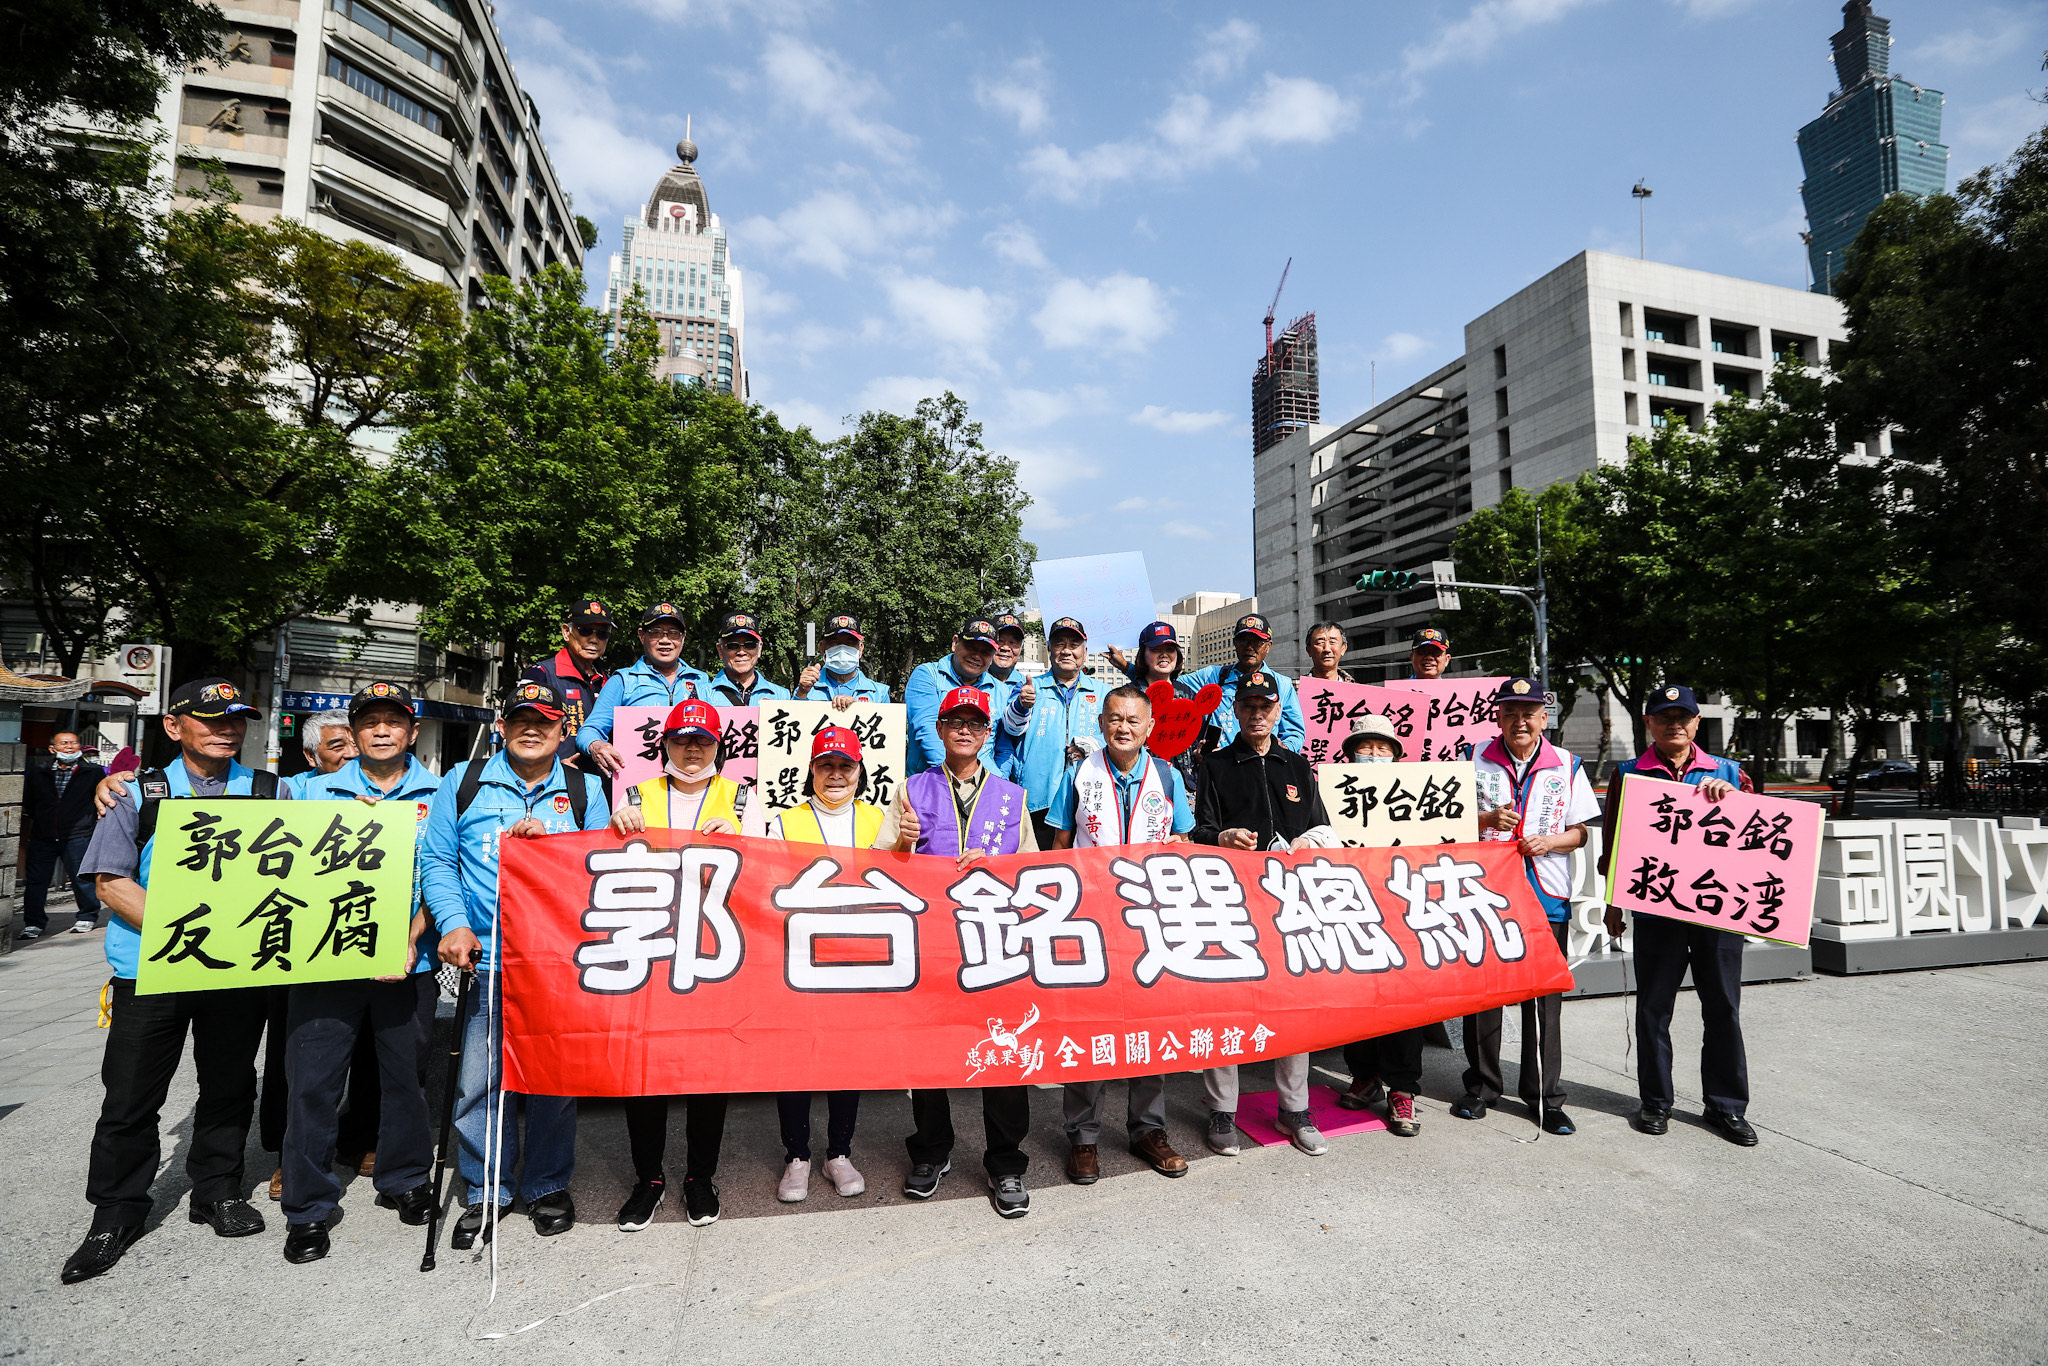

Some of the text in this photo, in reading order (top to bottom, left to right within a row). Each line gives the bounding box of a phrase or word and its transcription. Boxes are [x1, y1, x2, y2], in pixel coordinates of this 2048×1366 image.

[1334, 774, 1464, 827] 郭台銘
[1650, 793, 1793, 861] 郭台銘
[176, 811, 386, 882] 郭台銘
[148, 880, 380, 972] 反貪腐
[576, 840, 1525, 993] 郭台銘選總統
[1627, 856, 1785, 934] 救台湾
[1055, 1023, 1277, 1068] 全國關公聯誼會
